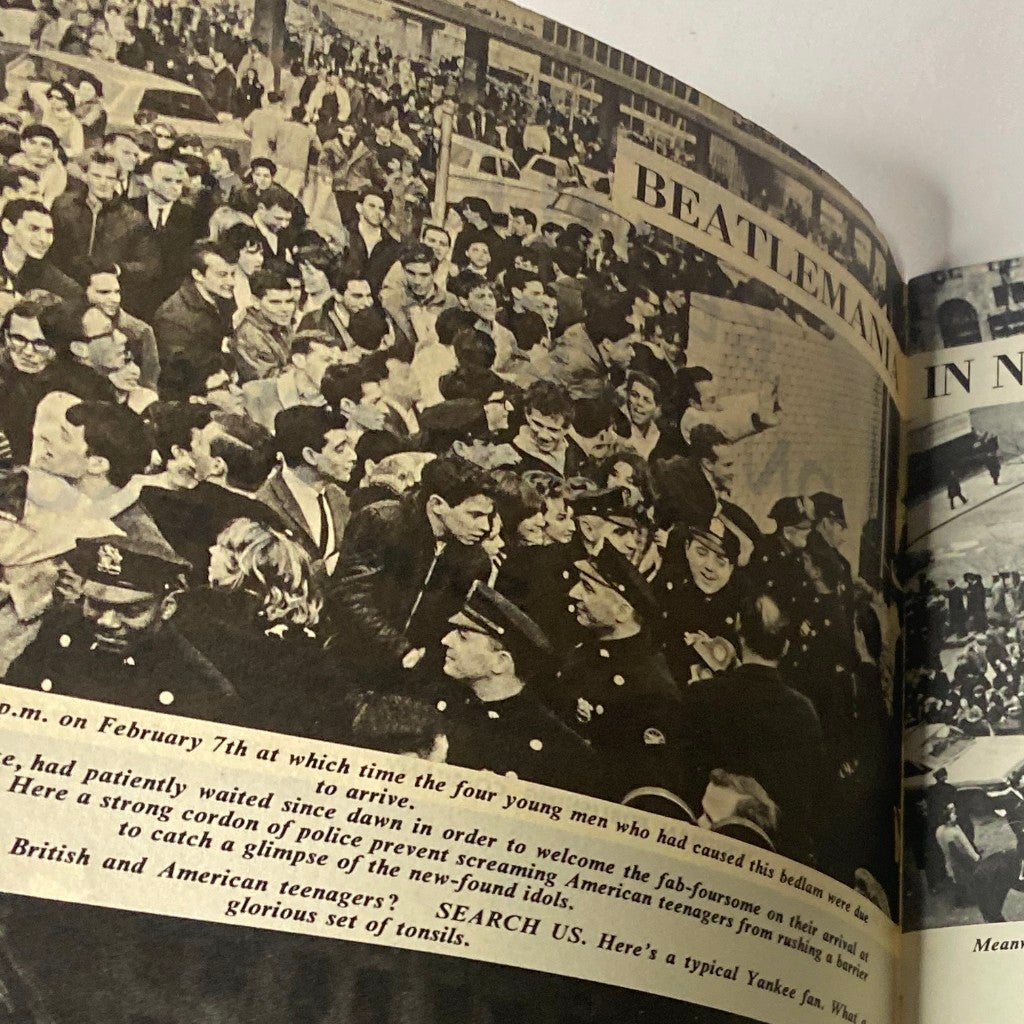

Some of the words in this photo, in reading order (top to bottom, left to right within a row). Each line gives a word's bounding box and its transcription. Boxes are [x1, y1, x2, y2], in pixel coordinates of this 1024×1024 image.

[924, 359, 976, 399] IN
[30, 754, 77, 777] had
[81, 768, 187, 799] patiently
[200, 786, 274, 809] waited
[281, 797, 337, 819] since
[347, 807, 403, 831] dawn
[412, 817, 433, 836] in
[442, 828, 498, 848] order
[506, 839, 526, 854] to
[537, 847, 615, 874] welcome
[623, 864, 651, 883] the
[654, 872, 761, 915] fab-foursome
[767, 910, 783, 923] on
[789, 915, 818, 936] their
[822, 932, 857, 955] arrival
[859, 951, 869, 963] at
[59, 715, 87, 729] on
[97, 716, 203, 752] February
[213, 736, 248, 757] 7th
[256, 749, 279, 762] at
[289, 752, 350, 774] which
[359, 762, 406, 784] time
[414, 773, 446, 792] the
[449, 780, 497, 802] four
[502, 795, 563, 821] young
[570, 810, 608, 828] men
[616, 821, 650, 839] who
[656, 828, 688, 850] had
[692, 844, 746, 868] caused
[749, 859, 774, 879] this
[779, 869, 823, 899] bedlam
[828, 893, 851, 912] were
[854, 905, 869, 923] due
[315, 780, 337, 796] to
[346, 788, 414, 810] arrive.
[7, 775, 68, 801] Here
[76, 792, 92, 805] a
[99, 796, 174, 822] strong
[181, 809, 259, 831] cordon
[267, 819, 296, 840] of
[294, 826, 363, 848] police
[367, 839, 449, 862] prevent
[455, 854, 558, 888] screaming
[564, 873, 652, 905] American
[658, 896, 734, 928] teenagers
[735, 917, 773, 940] from
[777, 934, 822, 962] rushing
[826, 953, 833, 964] a
[836, 954, 868, 981] barrier
[8, 837, 90, 866] British
[102, 857, 148, 874] and
[157, 861, 268, 892] American
[279, 881, 399, 911] teenagers?
[435, 902, 541, 936] SEARCH
[552, 923, 586, 945] US.
[597, 933, 658, 960] Here's
[665, 953, 676, 965] a
[684, 956, 740, 981] typical
[747, 970, 796, 999] Yankee
[799, 989, 824, 1010] fan.
[832, 1000, 857, 1024] What
[118, 822, 142, 838] to
[151, 829, 213, 849] catch
[221, 840, 235, 852] a
[242, 840, 329, 867] glimpse
[337, 854, 365, 875] of
[368, 858, 401, 877] the
[409, 869, 519, 898] new-found
[523, 885, 574, 910] idols.
[225, 896, 318, 923] glorious
[325, 914, 358, 929] set
[365, 917, 393, 937] of
[396, 922, 470, 947] tonsils.
